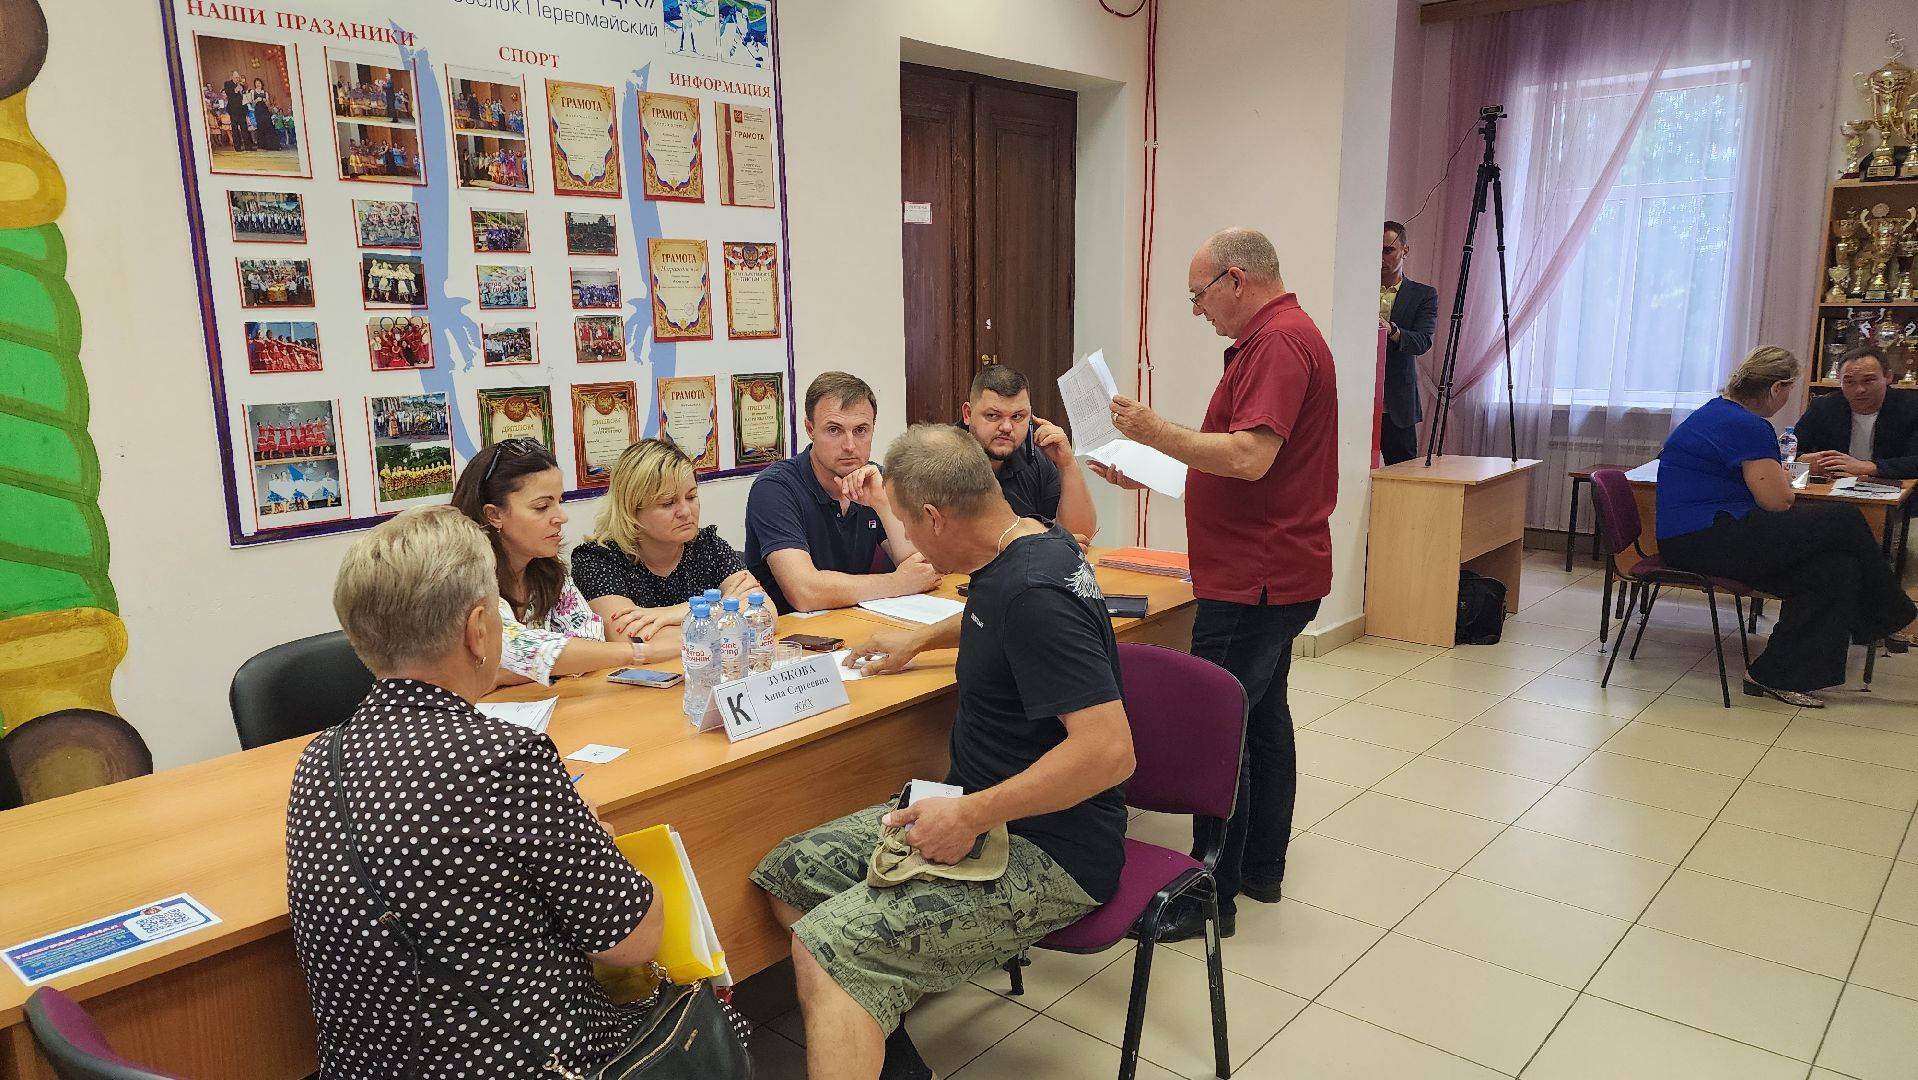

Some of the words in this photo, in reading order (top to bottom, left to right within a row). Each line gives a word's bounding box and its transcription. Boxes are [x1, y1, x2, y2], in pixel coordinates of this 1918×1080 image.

[187, 0, 266, 25] НАШИ
[275, 12, 415, 47] ПРАЗДНИКИ
[526, 0, 659, 38] Первомайский
[498, 46, 560, 69] СПОРТ
[669, 72, 772, 98] ИНФОРМАЦИЯ
[560, 96, 603, 112] ГРАМОТА
[652, 107, 689, 122] ГРАМОТА
[734, 130, 765, 141] ГРАМОТА
[661, 253, 697, 264] ГРАМОТА
[671, 389, 706, 401] ГРАМОТА
[766, 664, 817, 686] ЗУБКОВА
[763, 691, 786, 703] Анна
[787, 677, 830, 695] Сергеевна
